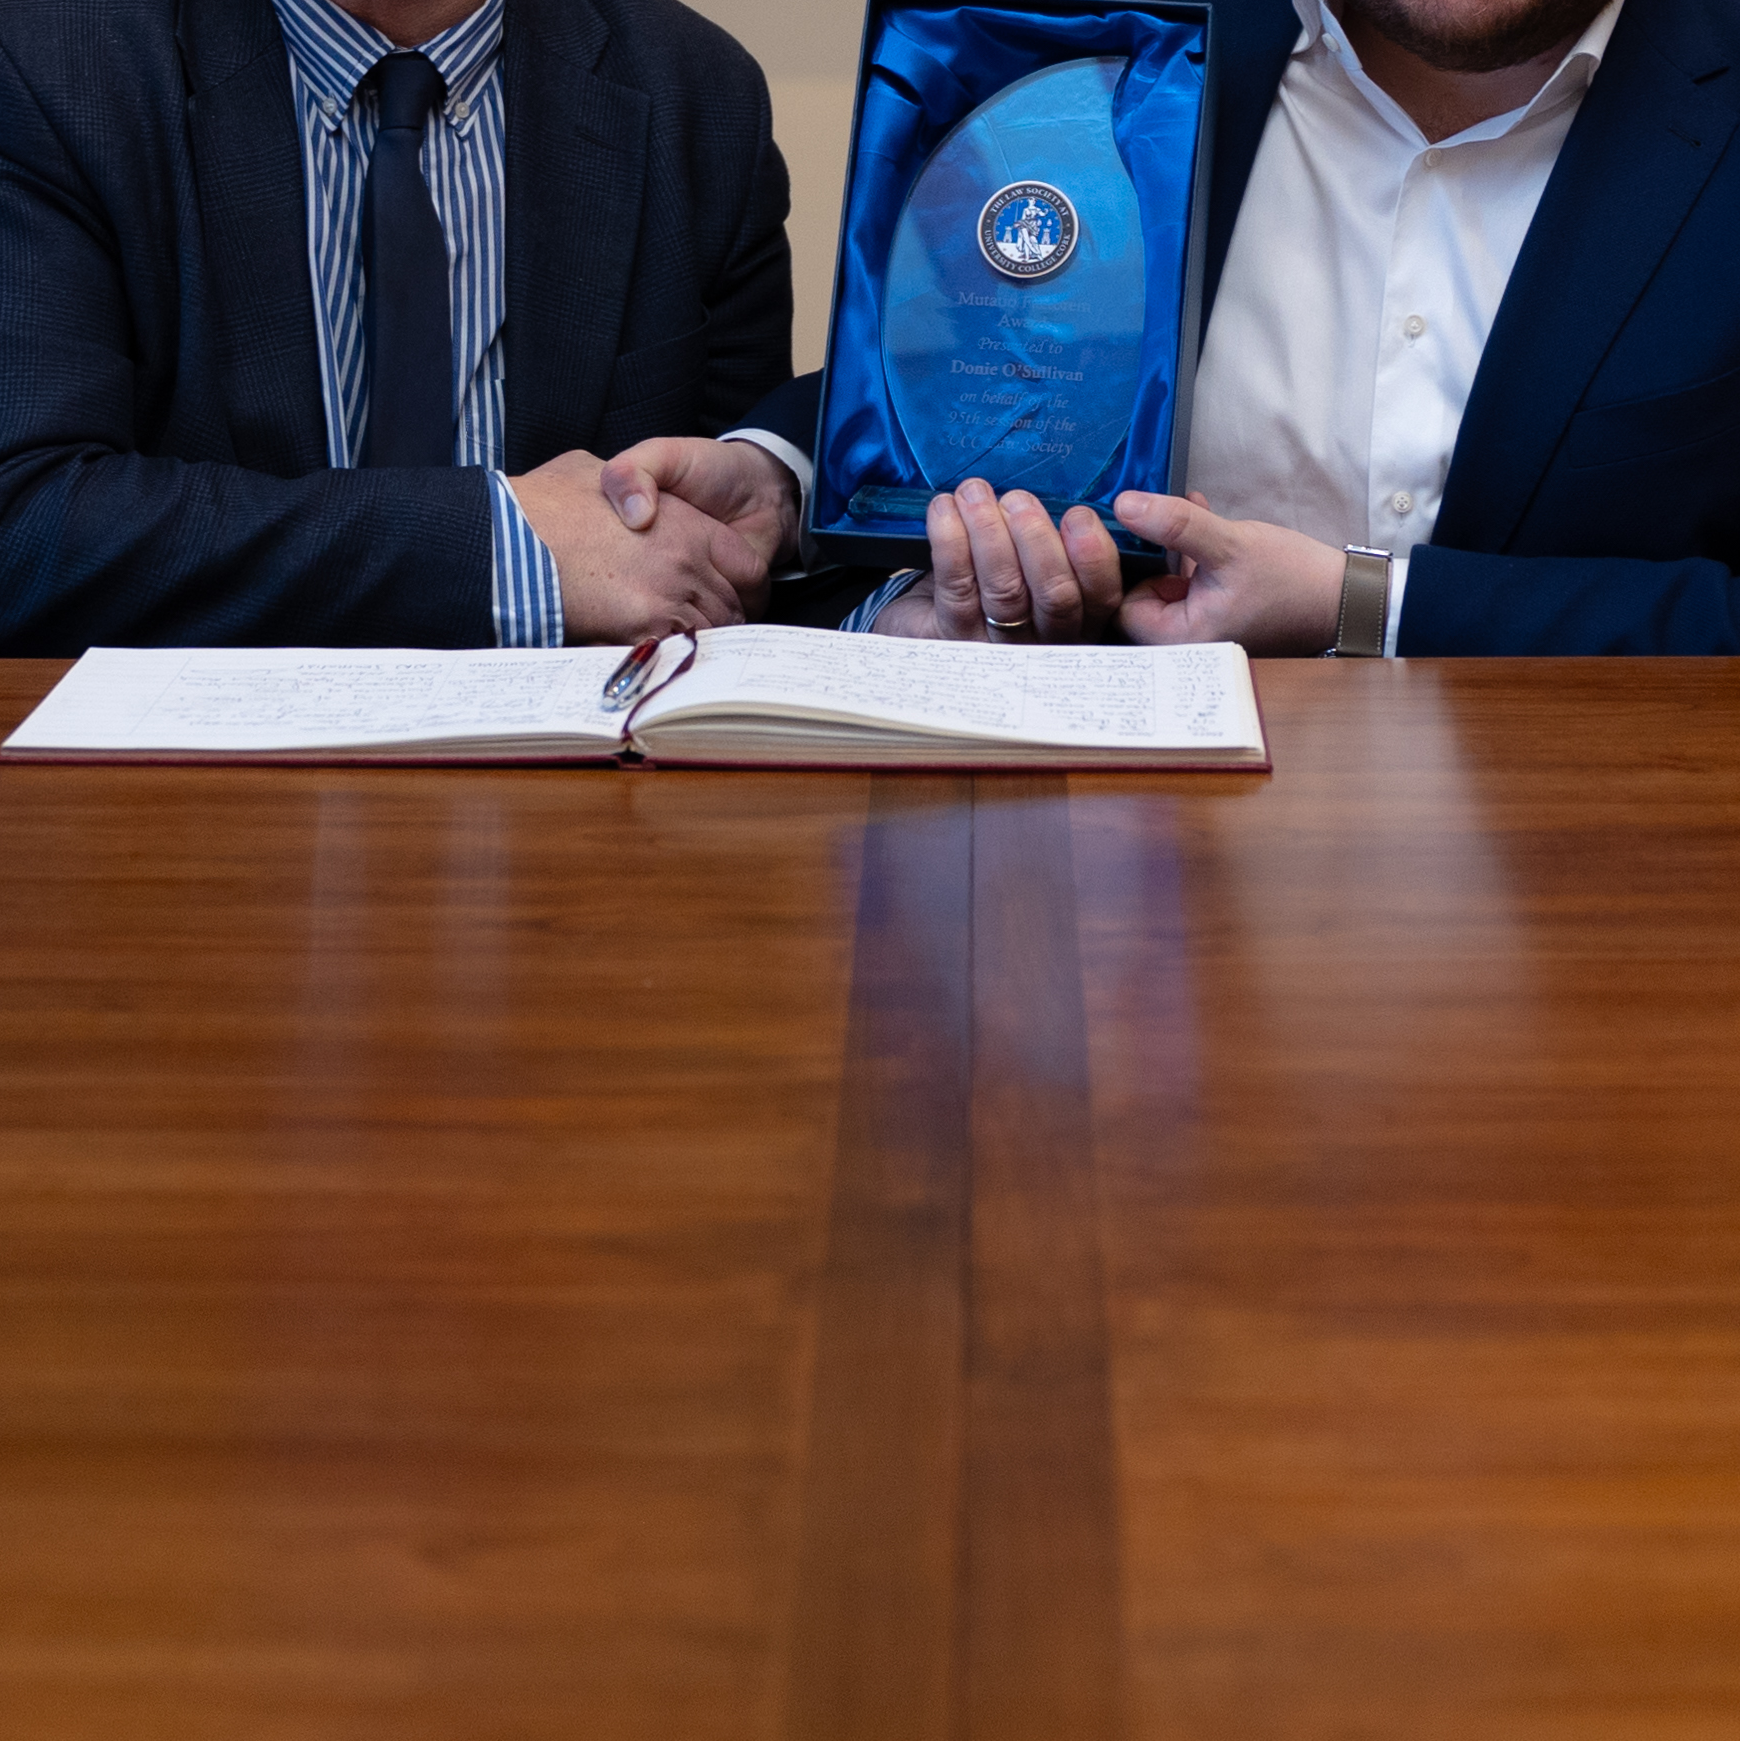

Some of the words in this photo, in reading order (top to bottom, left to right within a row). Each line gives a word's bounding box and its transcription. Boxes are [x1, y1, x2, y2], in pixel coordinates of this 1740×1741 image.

[989, 196, 1007, 213] THE
[1005, 187, 1024, 200] LAW
[1025, 186, 1061, 206] SOCIETY
[1058, 203, 1069, 217] AT
[984, 229, 1018, 271] UNIVERSITY
[1017, 255, 1059, 273] COLLEGE
[1056, 232, 1071, 258] CORK
[1049, 341, 1064, 355] to
[950, 359, 999, 377] Donie
[1002, 361, 1085, 382] O'Sullivan
[959, 392, 978, 403] on
[981, 390, 1025, 410] behalf
[1028, 393, 1046, 411] of
[1046, 392, 1070, 409] the
[948, 410, 981, 426] 95th
[1036, 415, 1055, 433] of
[1055, 416, 1077, 432] the
[947, 432, 981, 450] UCC
[1021, 438, 1074, 458] Society
